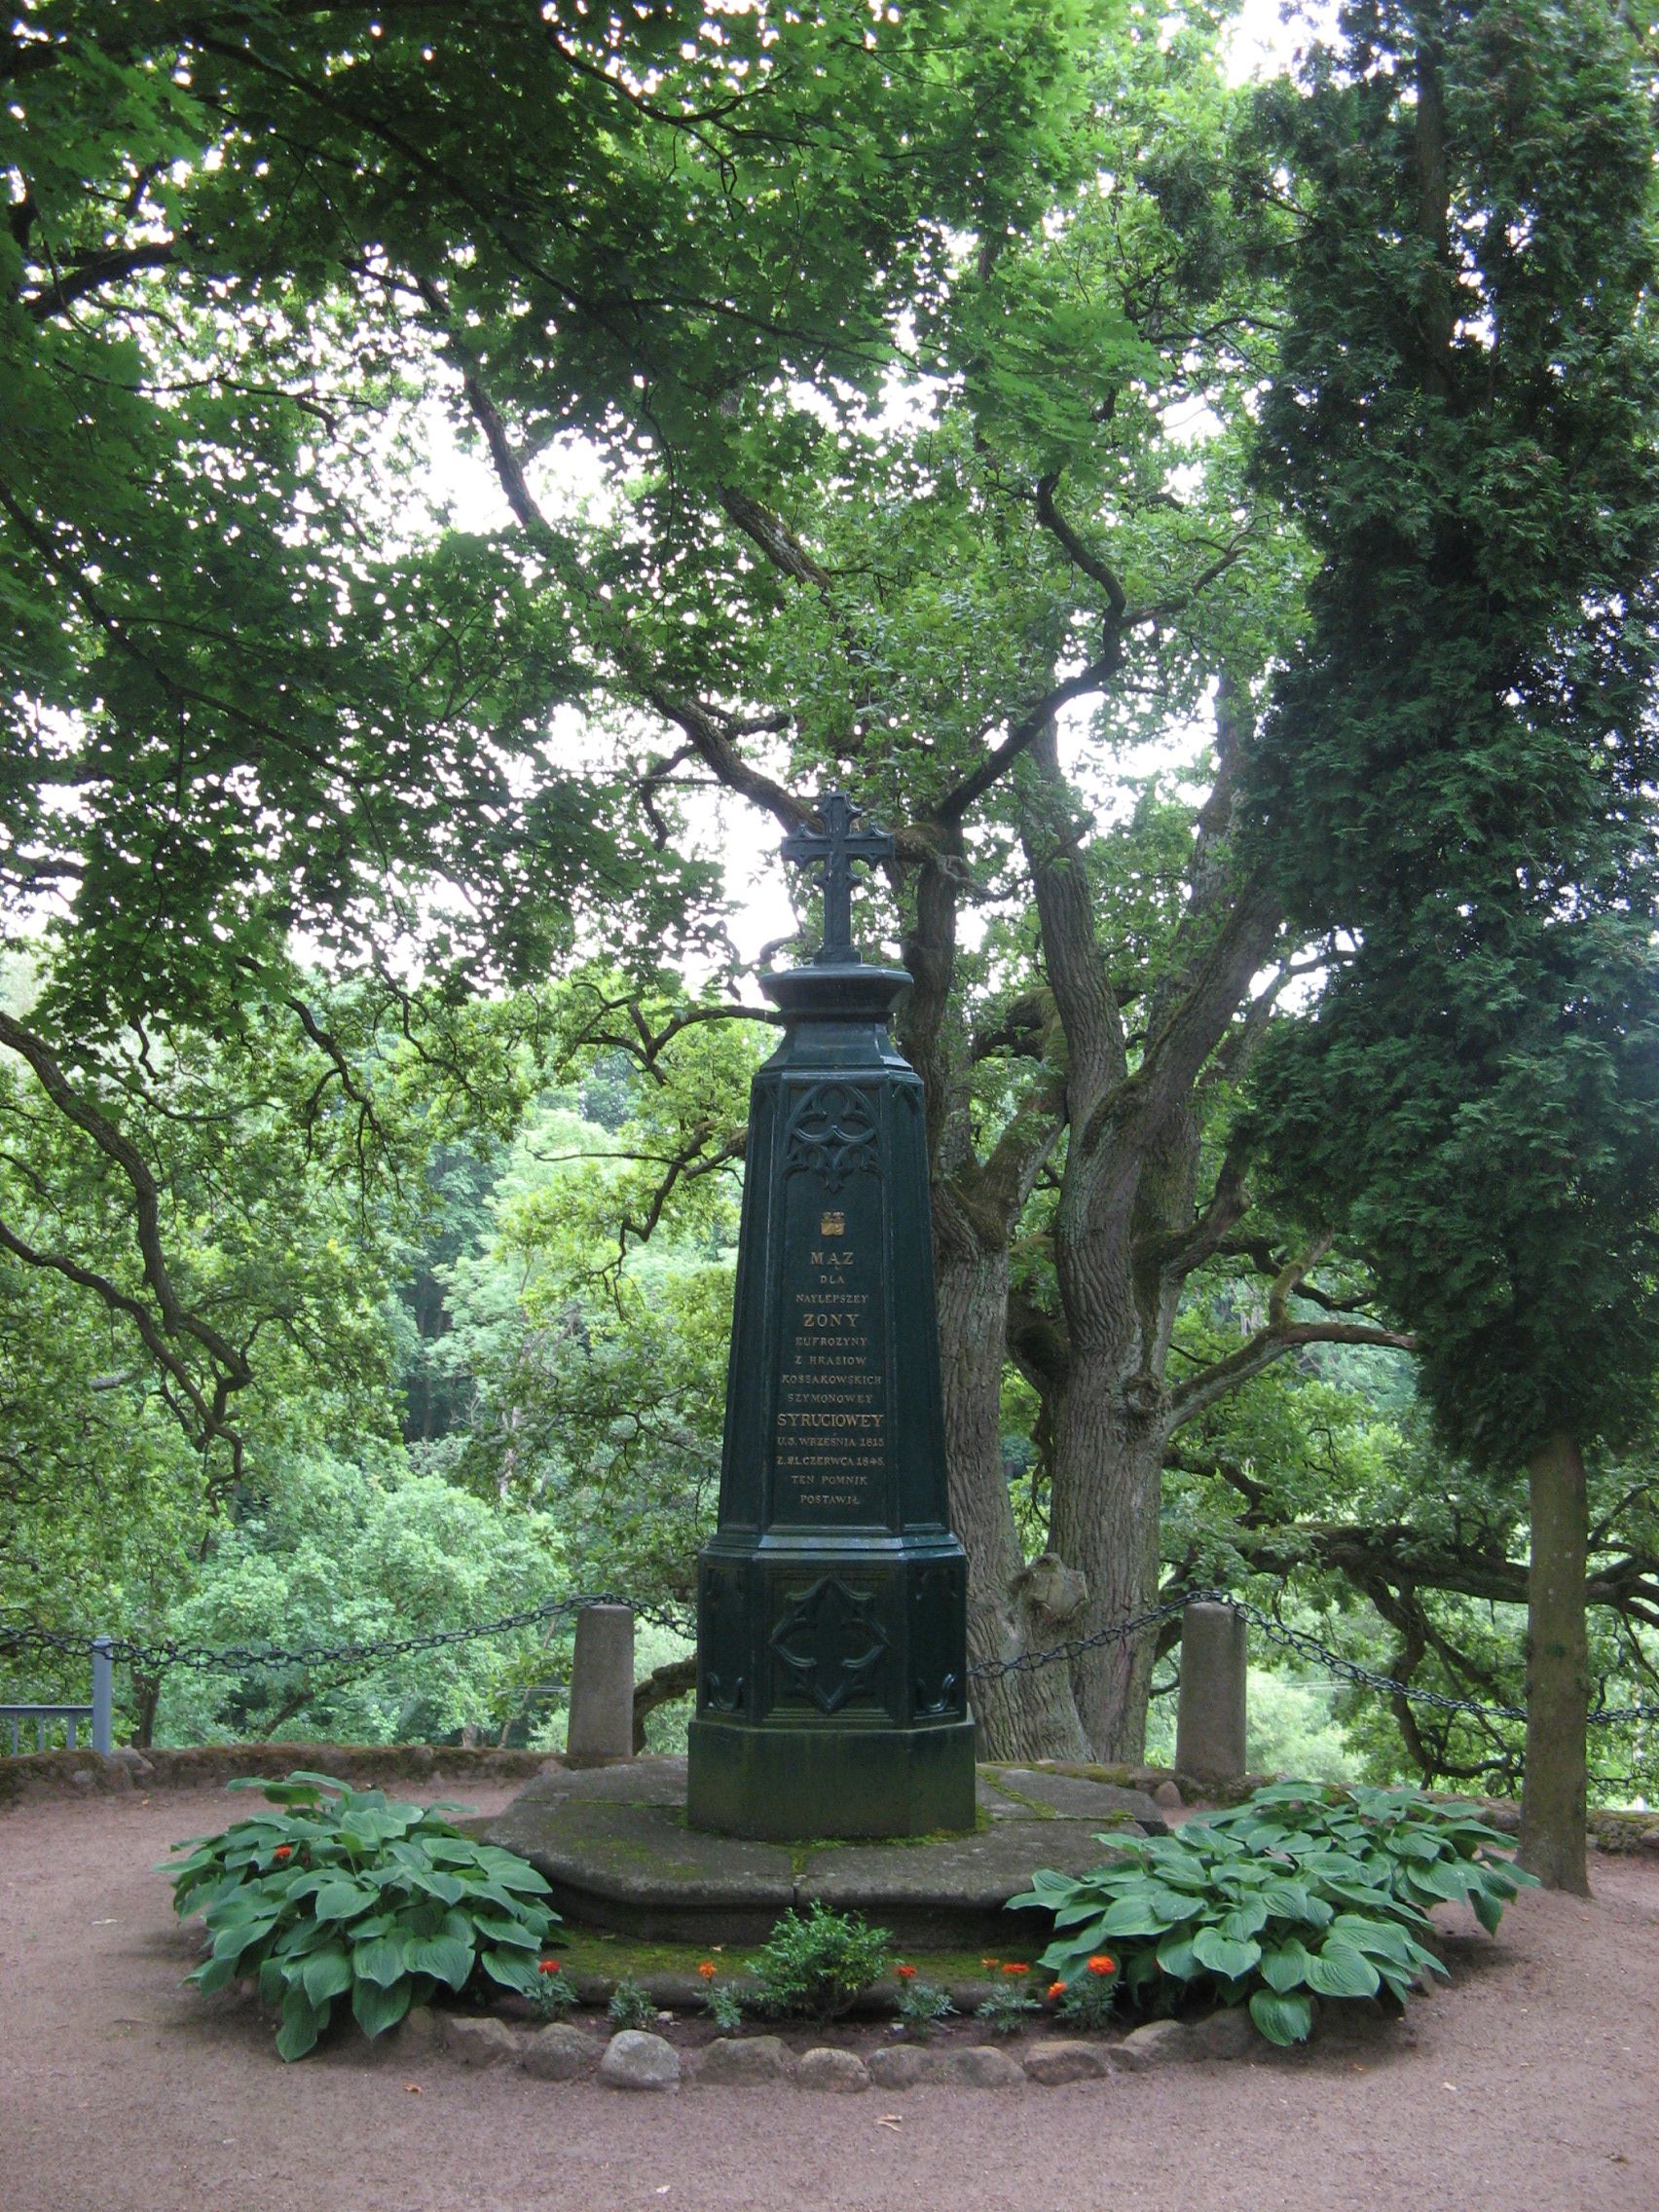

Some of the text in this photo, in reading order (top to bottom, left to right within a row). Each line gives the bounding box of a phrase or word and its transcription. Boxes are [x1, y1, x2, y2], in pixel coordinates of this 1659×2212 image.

[820, 1275, 845, 1284] DLA
[795, 1294, 868, 1304] NAYLEPSZEY
[795, 1337, 867, 1346] EUFROZYNY
[794, 1355, 802, 1365] Z
[782, 1374, 882, 1384] KOSSAKOWSKICH
[788, 1393, 873, 1404] SZYMONOWEY
[777, 1414, 884, 1427] SYRUCIOWEY
[791, 1475, 867, 1486] TEN POMNIK
